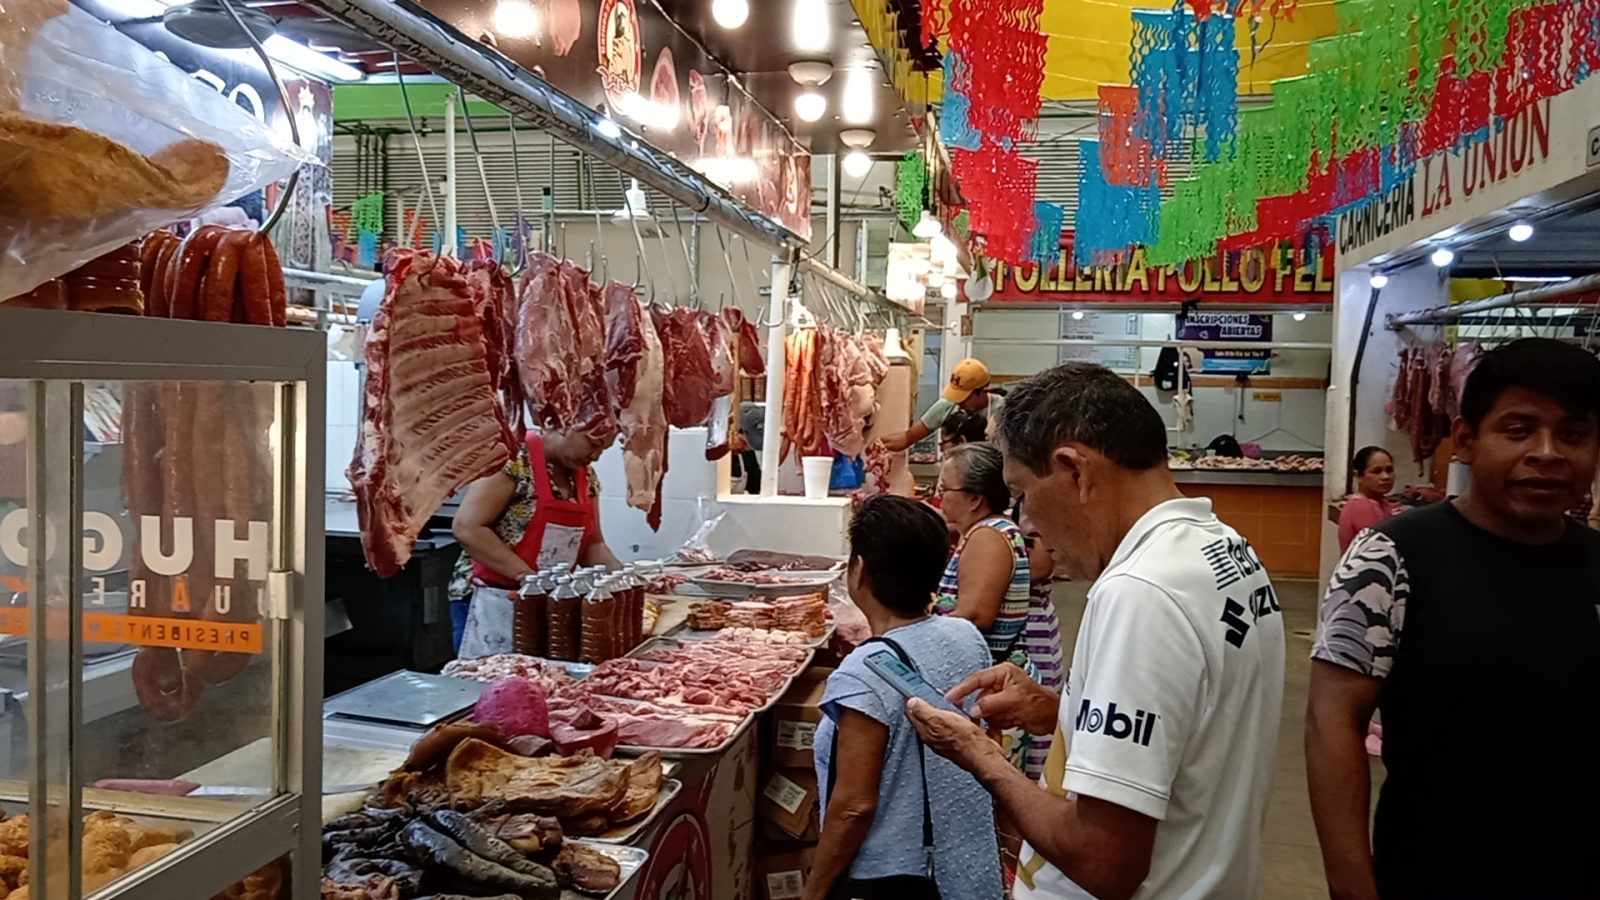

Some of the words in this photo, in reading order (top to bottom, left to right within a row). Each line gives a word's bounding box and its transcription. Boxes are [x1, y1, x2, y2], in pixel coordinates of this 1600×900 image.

[1421, 151, 1452, 217] LA
[1462, 98, 1550, 197] UNION
[1151, 246, 1266, 293] POLLO
[1185, 313, 1249, 326] INSCRIPCIONES
[1220, 325, 1262, 337] ABIERTAS
[1075, 699, 1156, 747] Mobil
